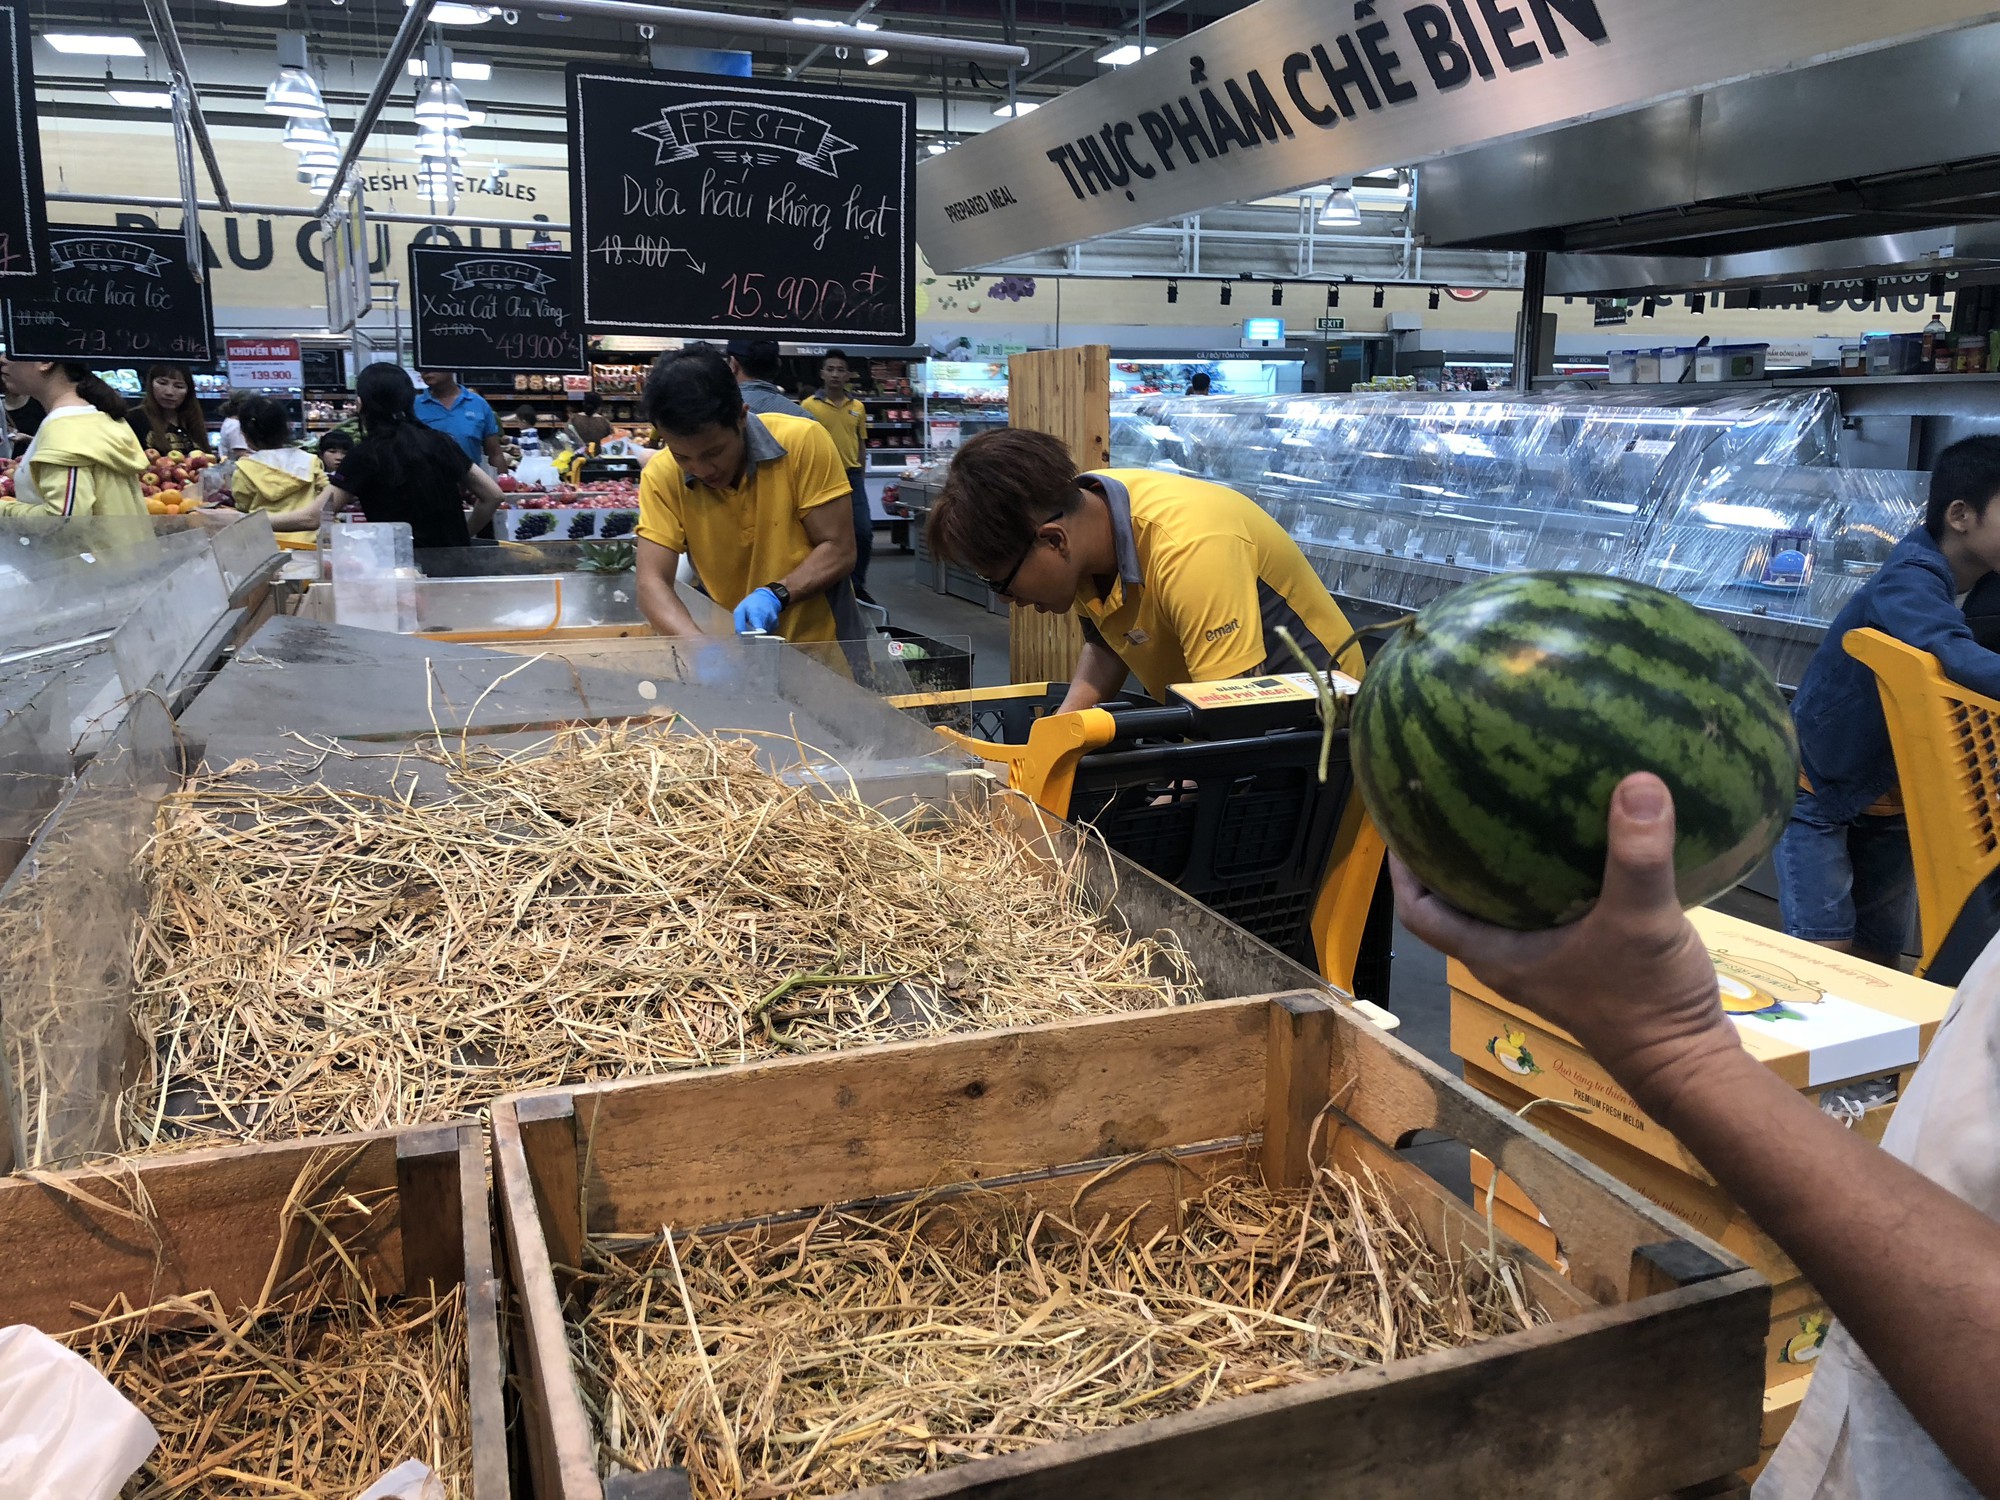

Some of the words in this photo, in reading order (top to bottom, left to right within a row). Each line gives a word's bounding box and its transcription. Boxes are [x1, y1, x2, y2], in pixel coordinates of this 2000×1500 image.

[679, 110, 806, 146] FRESH
[1046, 120, 1157, 202] THỰC
[1138, 56, 1294, 172] PHẨM
[361, 174, 409, 192] RESH
[766, 182, 833, 251] không
[844, 184, 900, 241] hạt
[943, 194, 989, 224] PREPARED
[985, 185, 1018, 211] MEAL
[62, 243, 140, 261] FRESH
[464, 264, 531, 280] FRESH
[1321, 319, 1342, 328] EXIT
[251, 370, 292, 380] 139.900
[1205, 617, 1241, 643] emart
[1573, 1087, 1601, 1110] PREMIUM
[1602, 1102, 1622, 1120] FRESH
[1622, 1112, 1645, 1132] MELON
